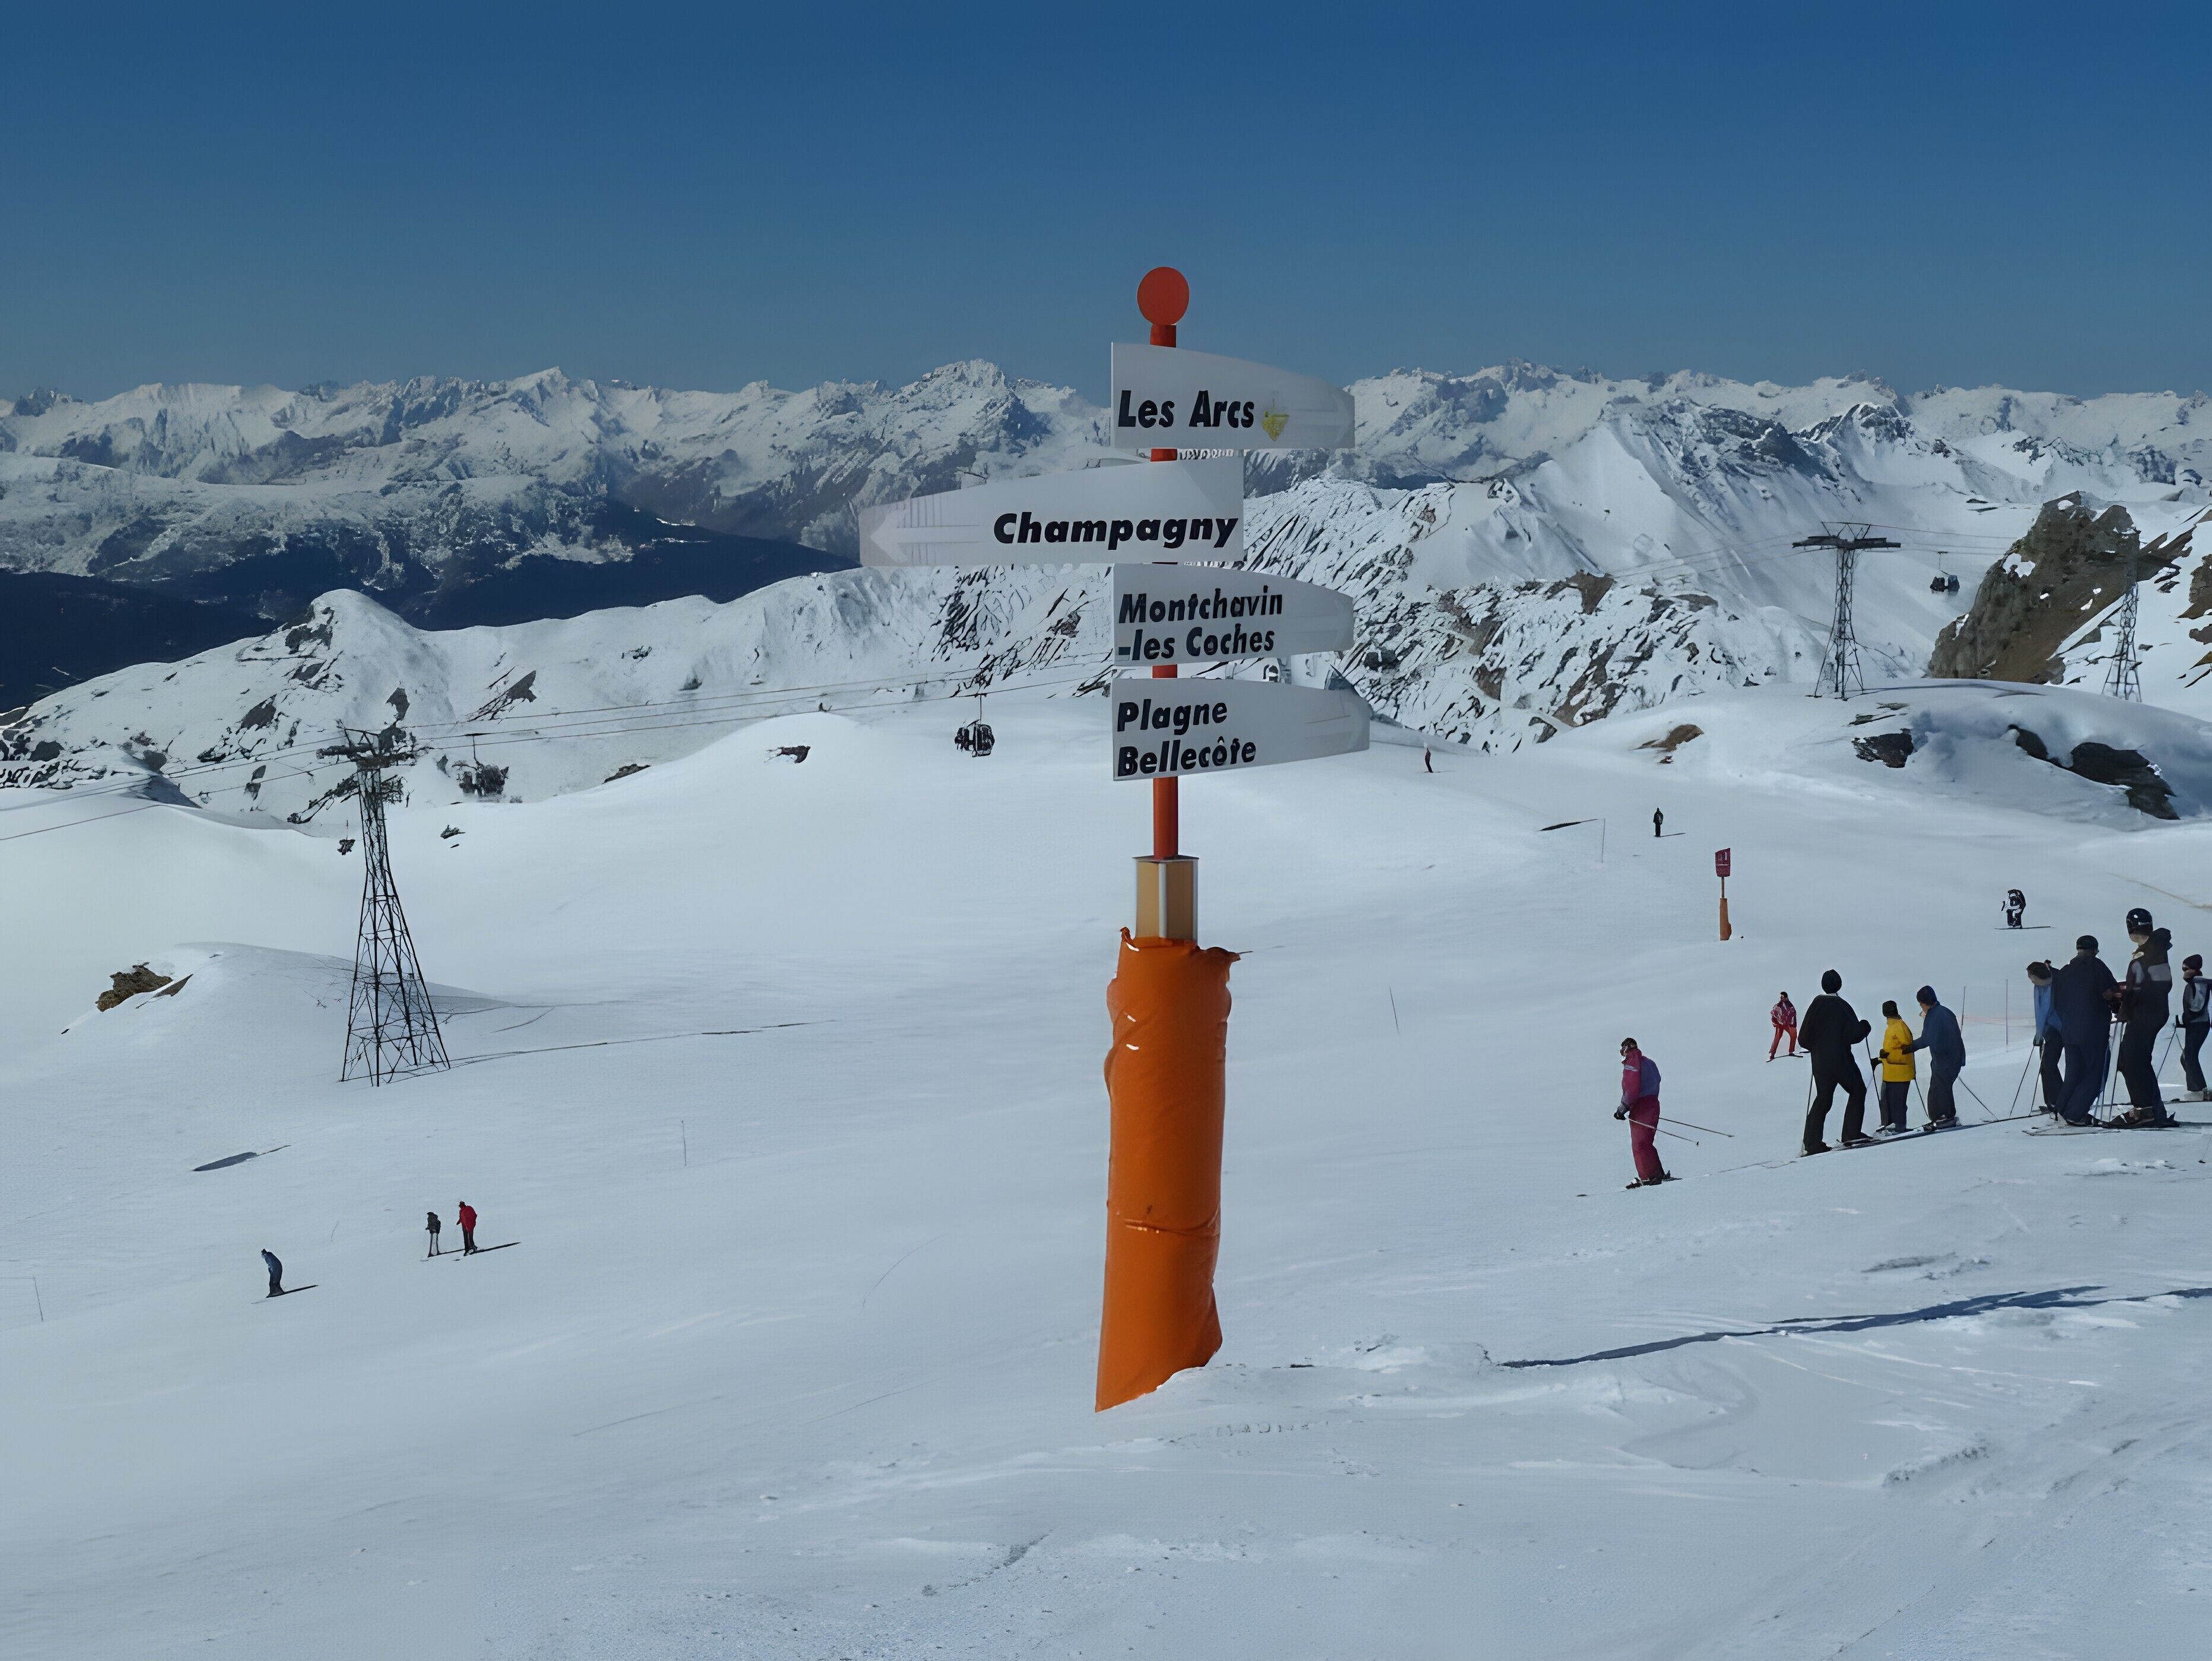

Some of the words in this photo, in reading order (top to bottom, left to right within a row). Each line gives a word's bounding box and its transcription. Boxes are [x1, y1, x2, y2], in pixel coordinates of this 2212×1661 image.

[1118, 390, 1175, 428] Les
[1188, 390, 1254, 428] Arcs
[994, 511, 1239, 551] Champagny
[1118, 585, 1282, 623] Montchavin
[1186, 623, 1275, 657] Coches
[1117, 698, 1228, 736] Plagne
[1117, 736, 1257, 777] Bellecôte
